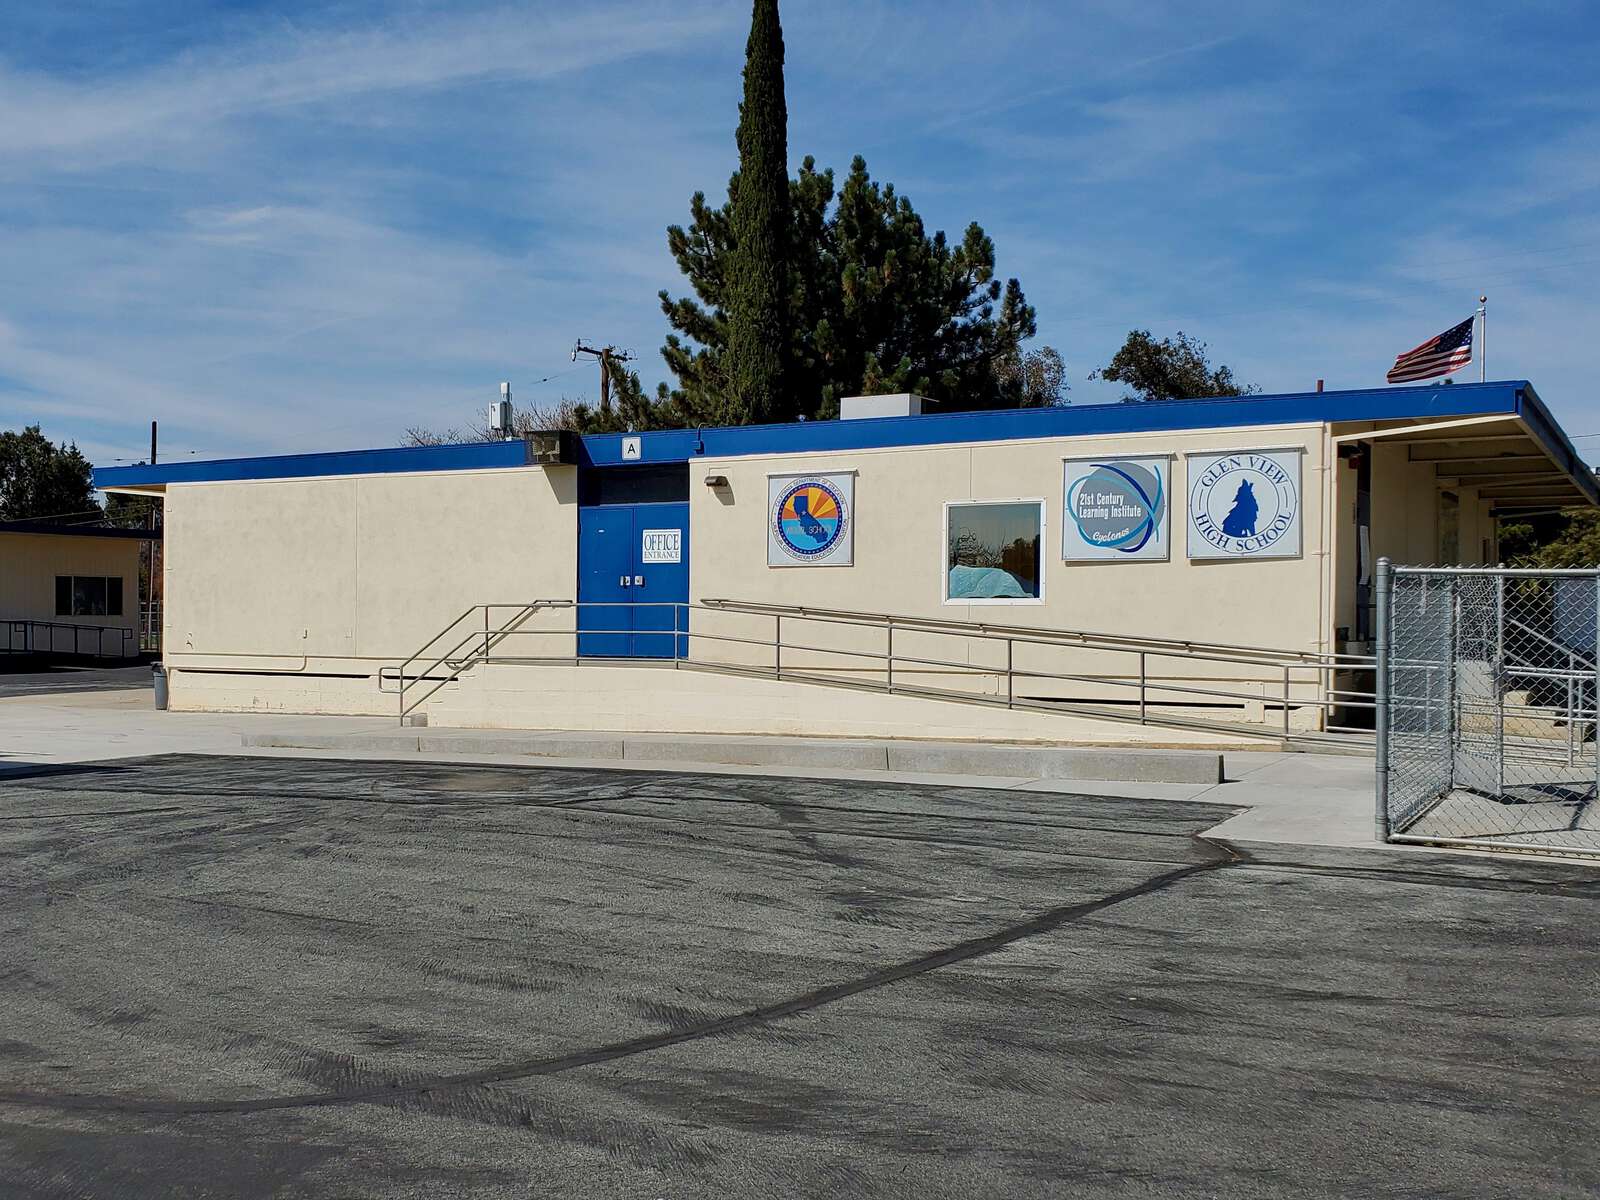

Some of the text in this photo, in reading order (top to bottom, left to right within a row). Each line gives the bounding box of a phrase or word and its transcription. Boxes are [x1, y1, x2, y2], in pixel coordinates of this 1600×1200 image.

[627, 443, 636, 454] A
[1201, 456, 1288, 487] GLEN VIEW
[1080, 492, 1124, 506] 21st Century
[1080, 505, 1142, 520] Learning Institute
[1092, 527, 1130, 544] Cyclones
[1196, 511, 1292, 551] HIGH SCHOOL
[644, 533, 679, 551] OFFICE
[644, 551, 679, 559] ENTRANCE
